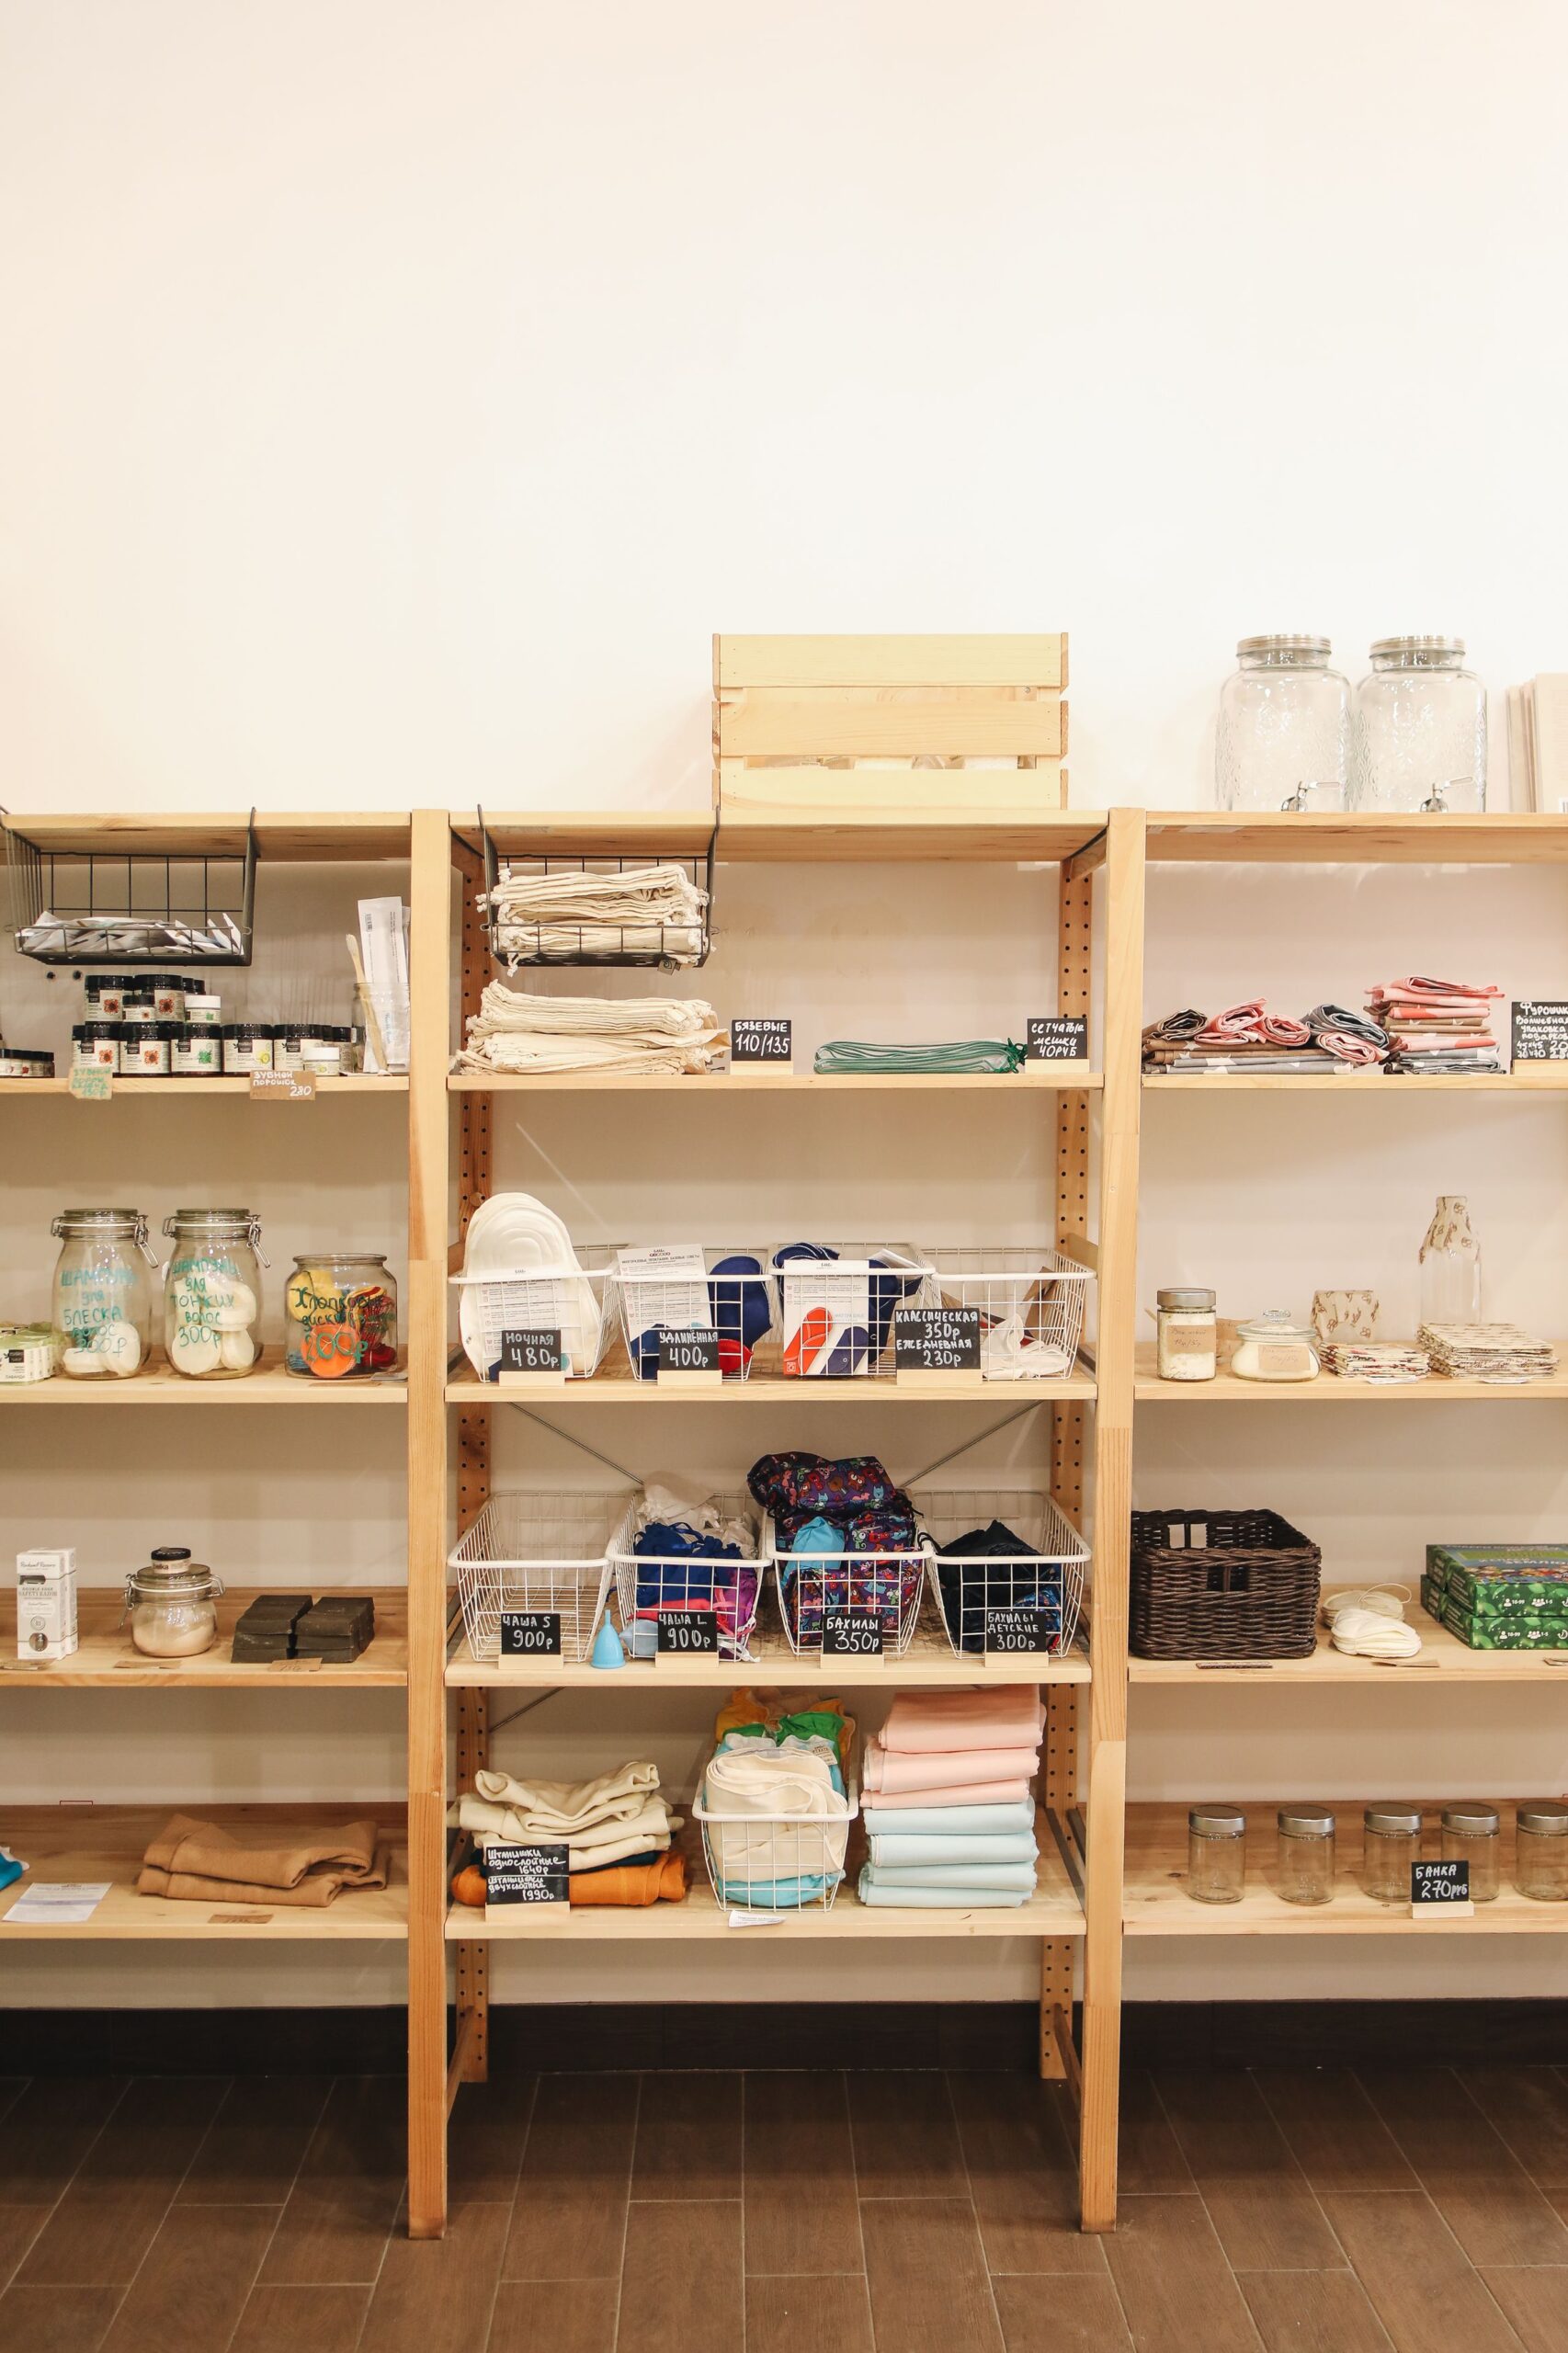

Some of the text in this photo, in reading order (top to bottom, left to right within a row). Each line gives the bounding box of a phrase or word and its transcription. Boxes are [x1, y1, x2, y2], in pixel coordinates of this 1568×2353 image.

[735, 1021, 788, 1032] БЯЗЕВЫЕ
[735, 1034, 790, 1056] 110/135
[290, 1086, 312, 1097] 280
[63, 1306, 122, 1325] БЛЕСКА
[895, 1311, 978, 1324] КЛАССИЧЕСКАЯ
[506, 1332, 554, 1346] НОЧНАЯ
[659, 1329, 718, 1345] УДЛИНЁННАЯ
[924, 1323, 960, 1340] 350р
[896, 1338, 972, 1351] ЕЖЕДНЕВНАЯ
[669, 1346, 709, 1368] 400р
[923, 1349, 961, 1367] 230р
[502, 1615, 551, 1628] ЧАША S
[658, 1613, 707, 1625] ЧАША L
[826, 1617, 878, 1631] БАХИЛЫ
[987, 1612, 1034, 1624] БАХИЛЫ
[987, 1623, 1040, 1634] ДЕТСКИЕ
[513, 1630, 553, 1650] 900р
[667, 1628, 710, 1649] 900р
[835, 1631, 880, 1653] 350р
[996, 1634, 1036, 1651] 300р
[1415, 1864, 1457, 1880] БАНКА
